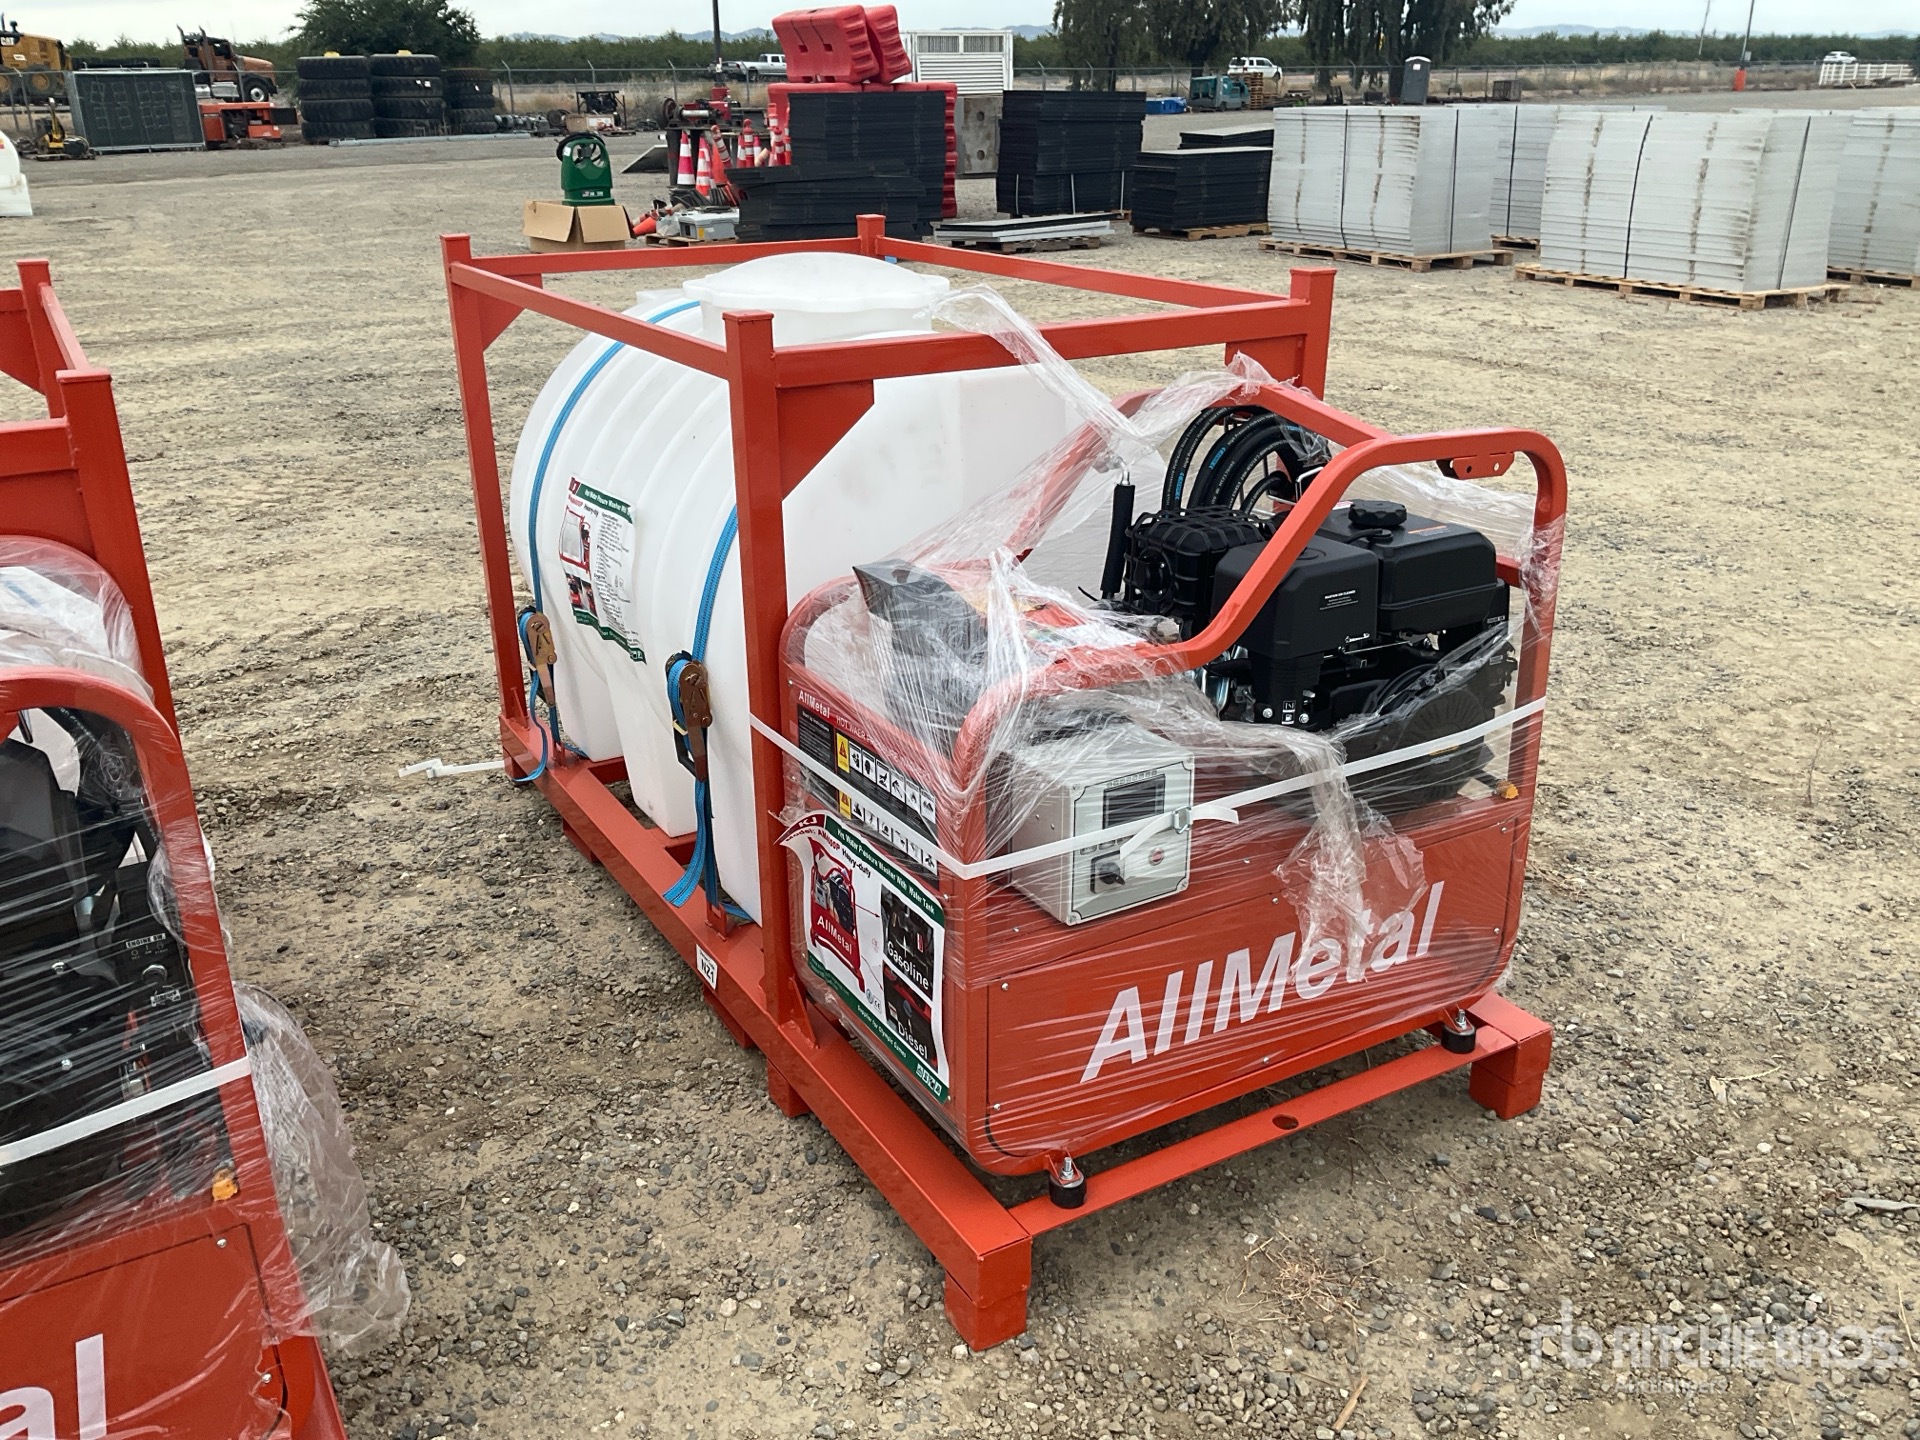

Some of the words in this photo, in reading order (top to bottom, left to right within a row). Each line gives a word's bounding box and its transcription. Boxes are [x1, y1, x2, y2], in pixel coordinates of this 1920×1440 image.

[799, 690, 830, 718] AllMetal
[798, 817, 818, 827] KJ
[908, 885, 923, 900] Water
[923, 899, 935, 914] Tank
[817, 915, 852, 954] AllMetal
[887, 941, 929, 990] Gasoline
[1080, 880, 1444, 1084] AllMetal
[898, 1021, 928, 1059] Diesel
